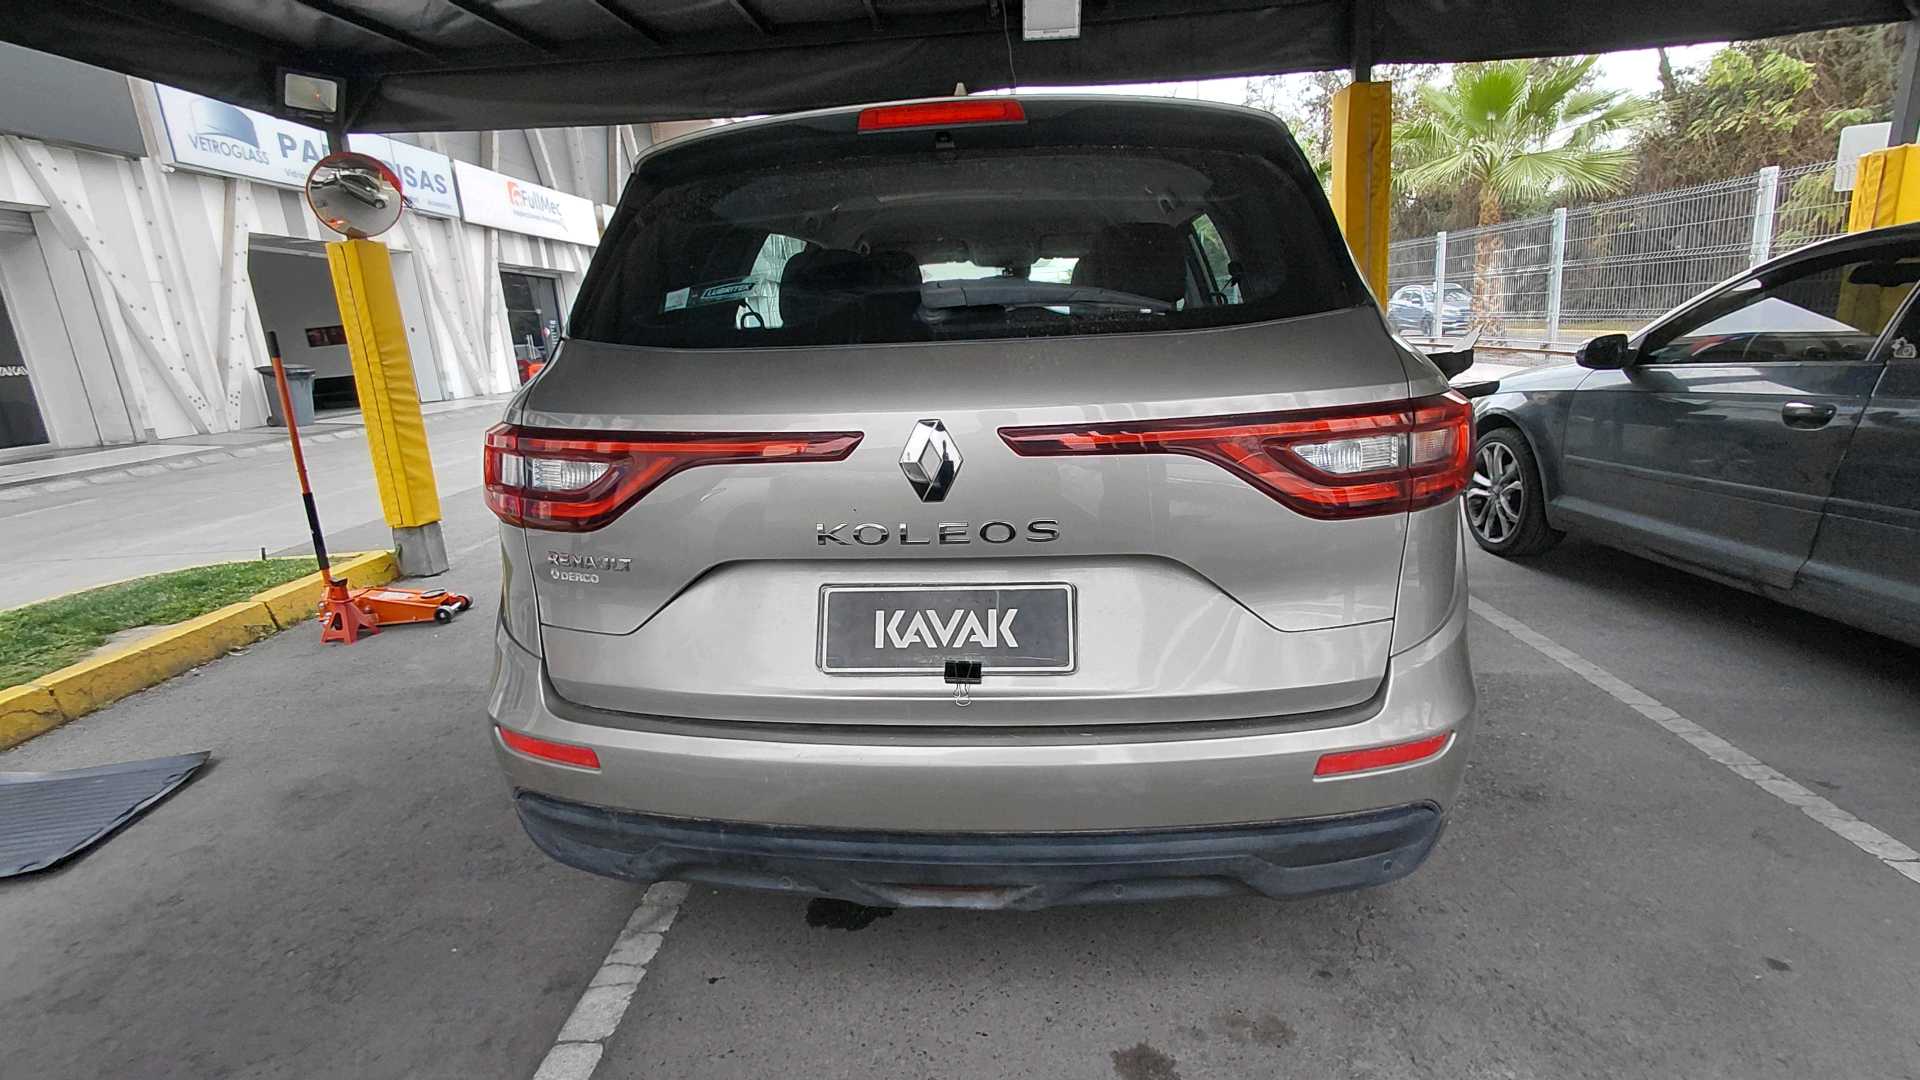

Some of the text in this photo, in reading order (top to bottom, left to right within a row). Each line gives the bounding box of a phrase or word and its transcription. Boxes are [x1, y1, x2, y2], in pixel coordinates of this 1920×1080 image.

[187, 132, 270, 165] VETROGLASS
[815, 519, 1061, 546] KOLEOS
[546, 550, 632, 572] RENAULT
[561, 570, 600, 584] DERCO
[874, 608, 1019, 649] KAVAK
